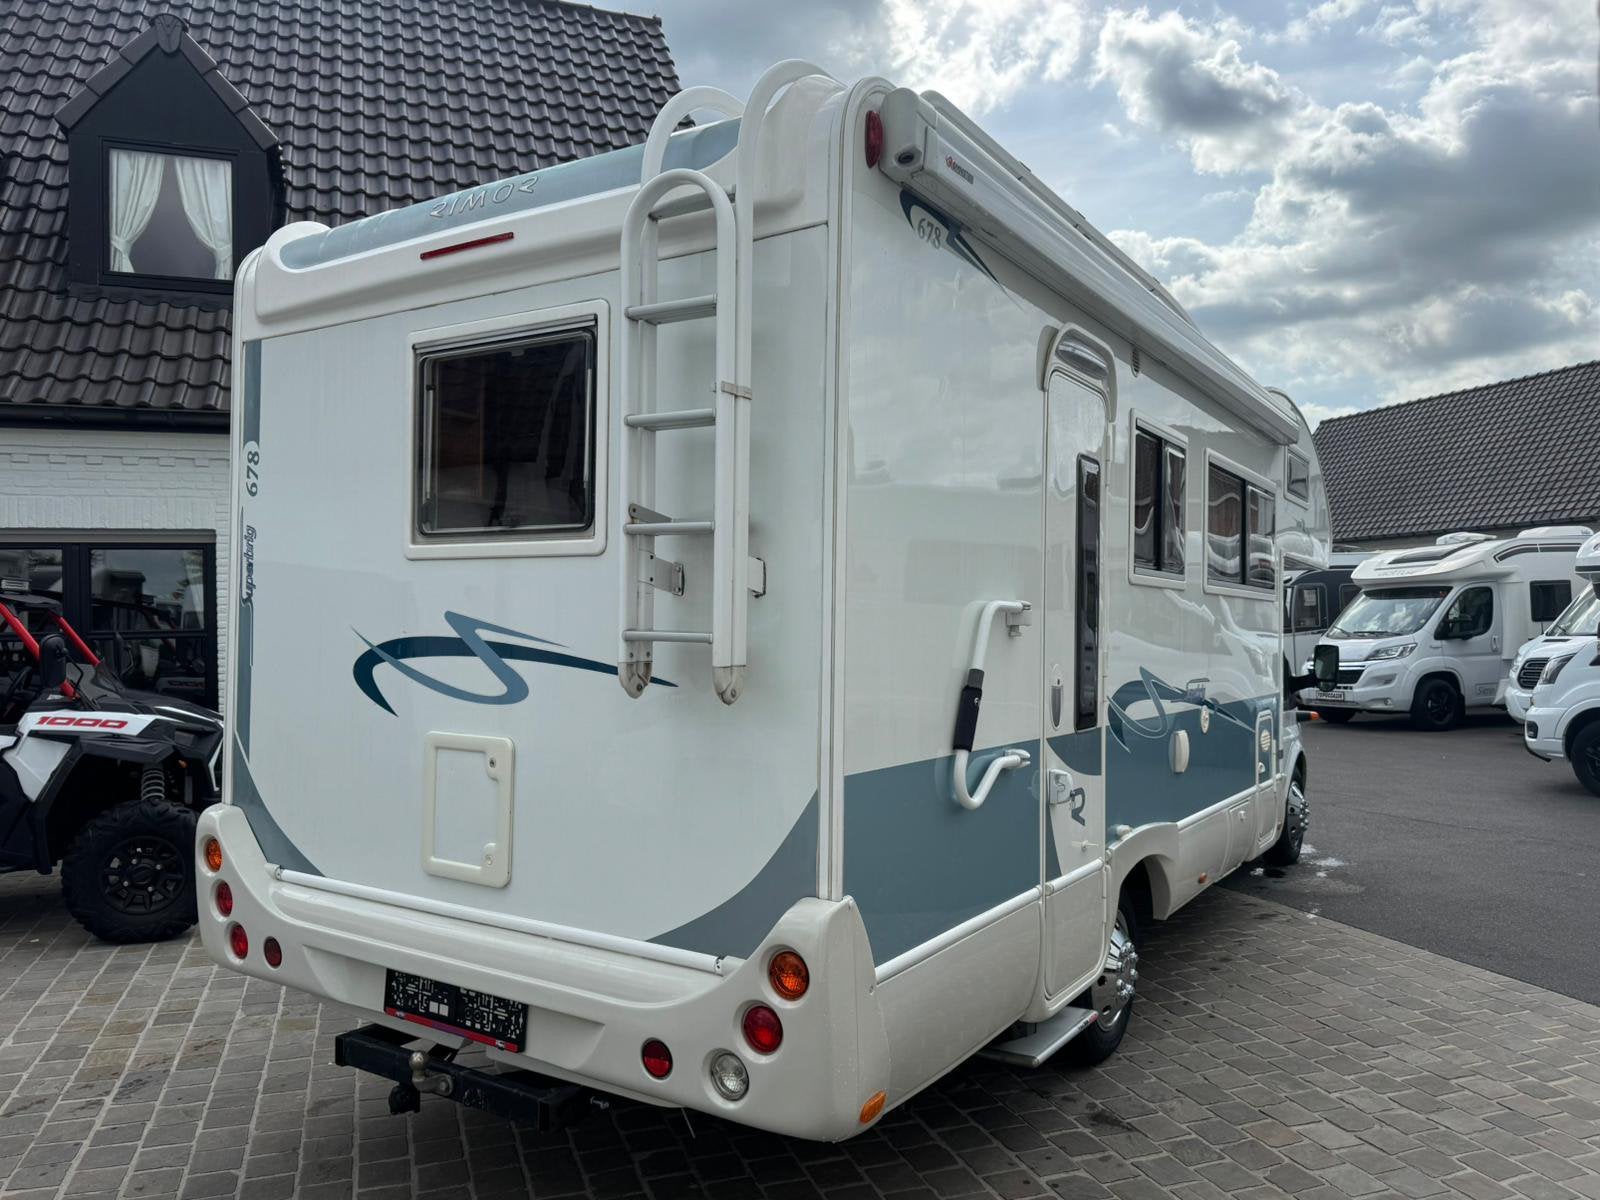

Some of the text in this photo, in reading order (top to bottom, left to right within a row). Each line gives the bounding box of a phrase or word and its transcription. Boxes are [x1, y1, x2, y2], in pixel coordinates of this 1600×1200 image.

[429, 175, 540, 218] RIMOR
[917, 218, 942, 250] 678
[246, 450, 260, 498] 678
[36, 716, 128, 729] 1000
